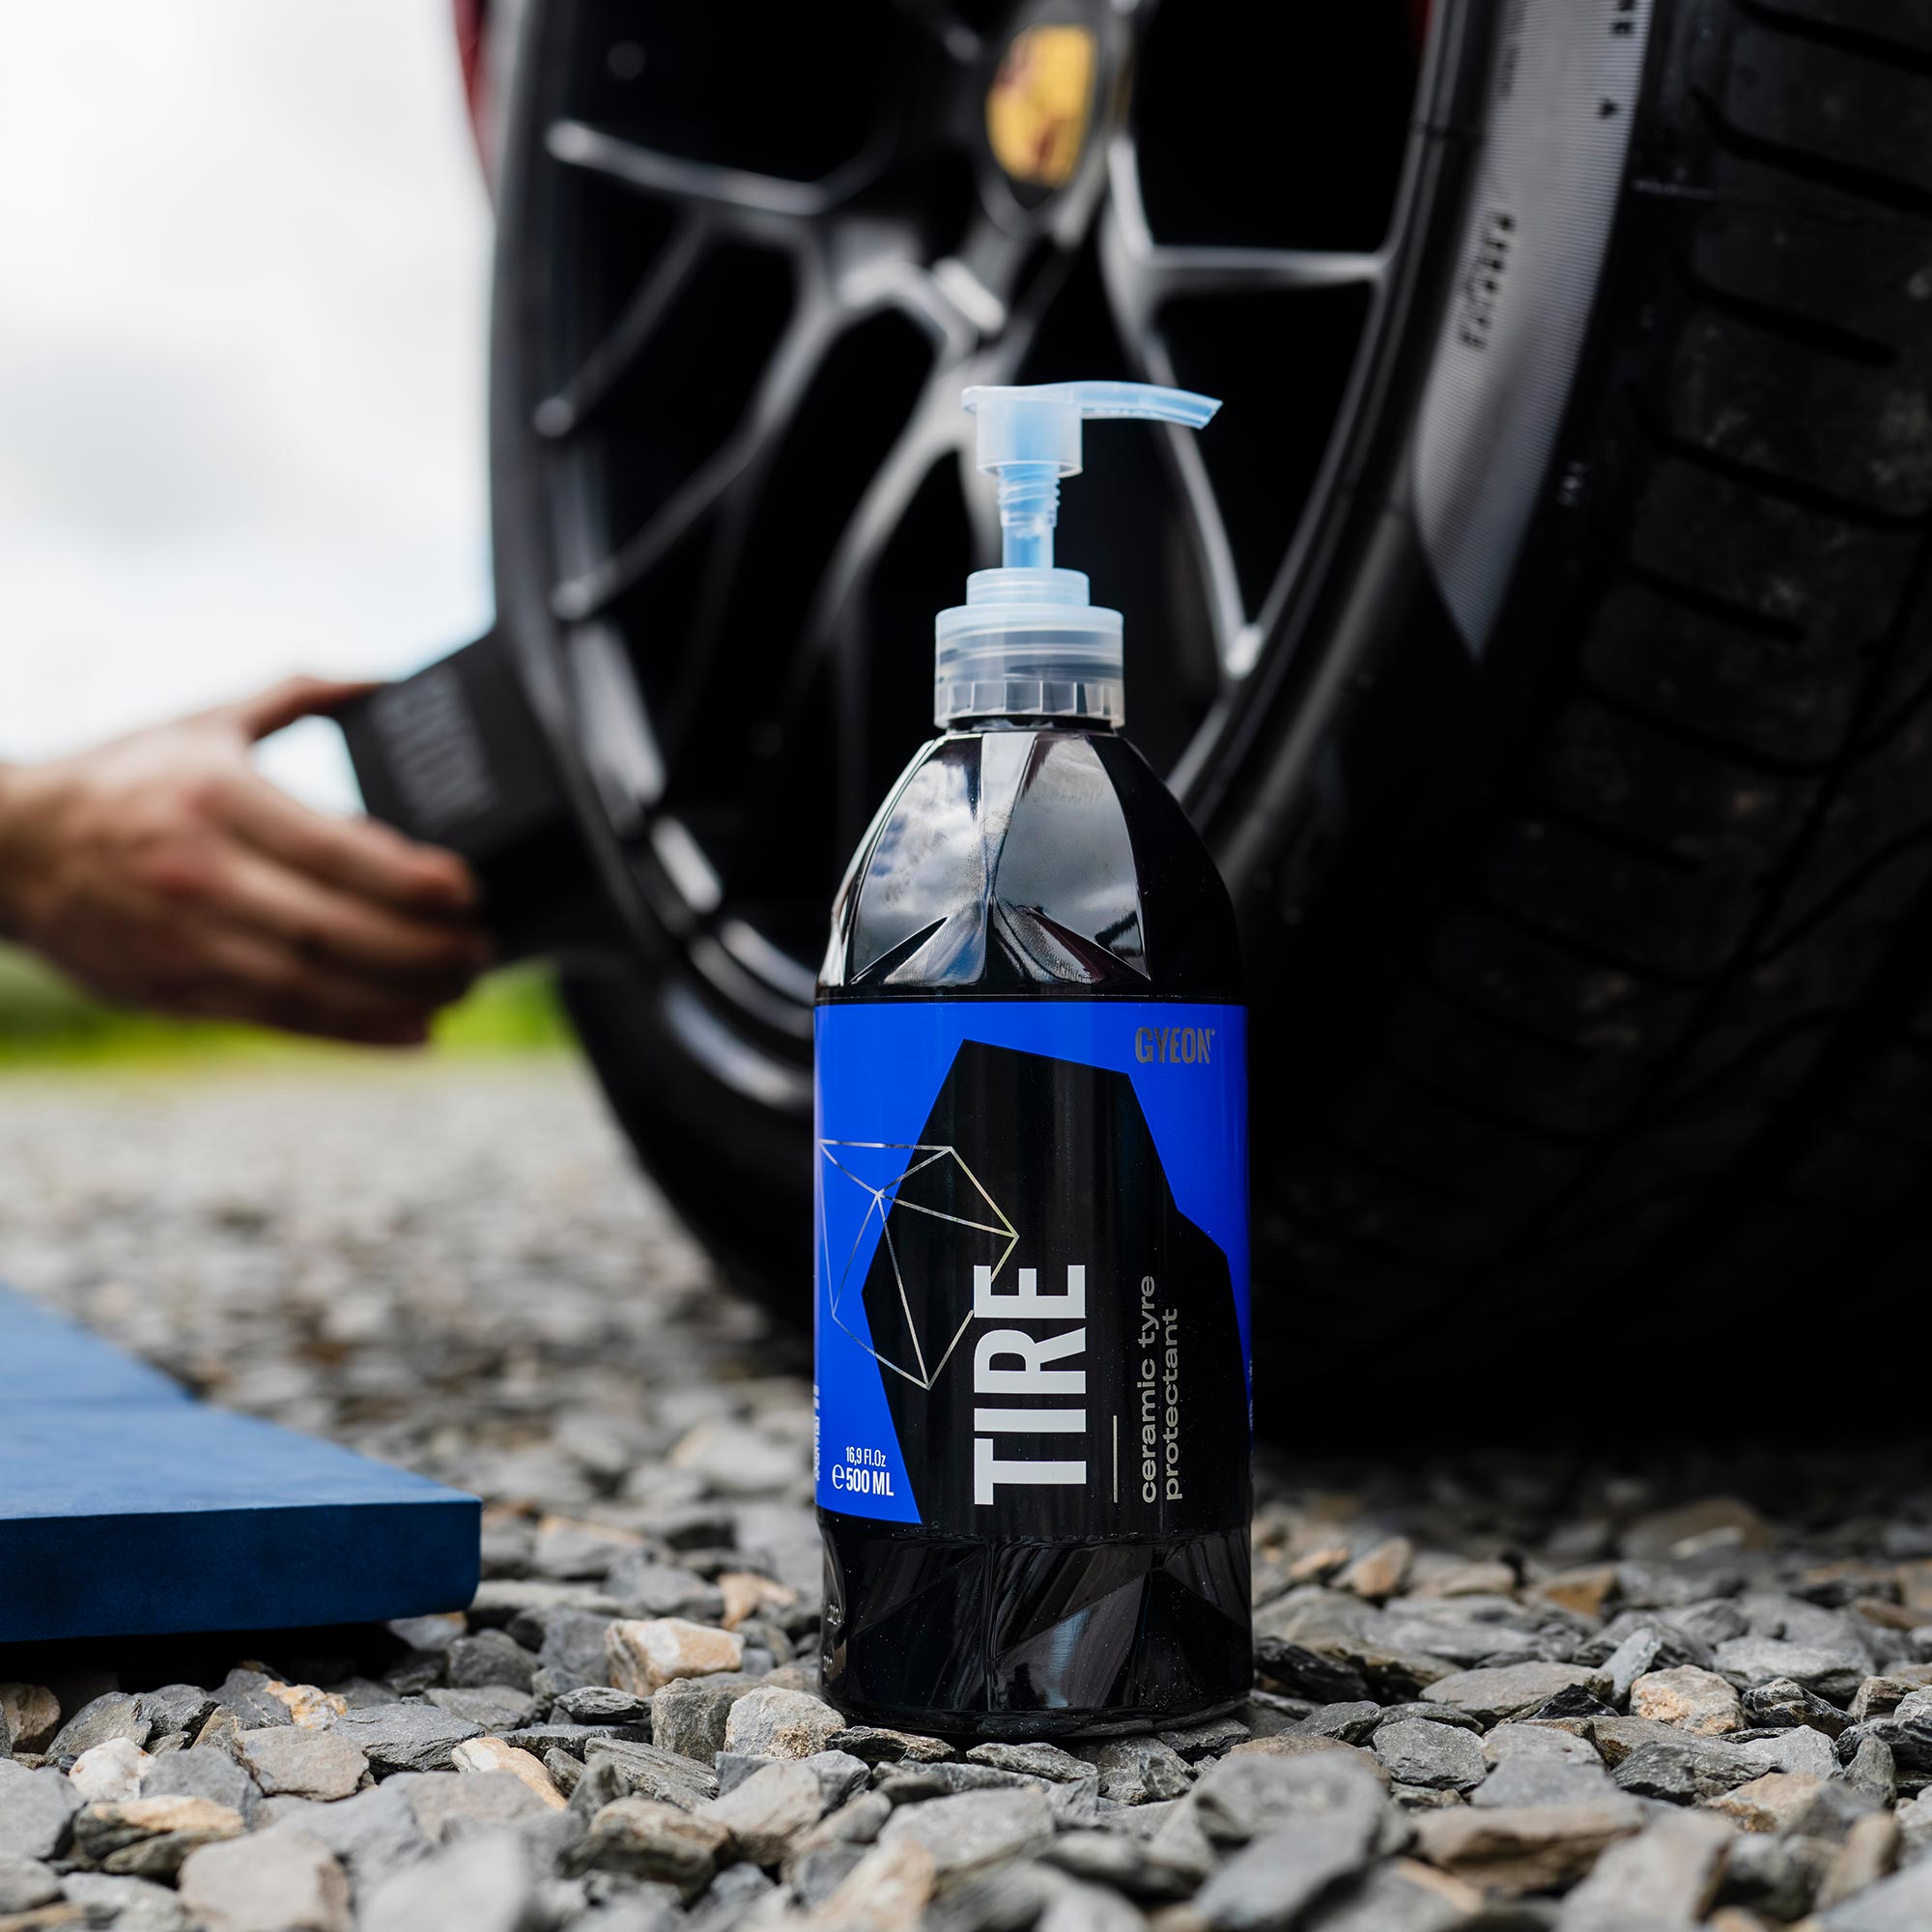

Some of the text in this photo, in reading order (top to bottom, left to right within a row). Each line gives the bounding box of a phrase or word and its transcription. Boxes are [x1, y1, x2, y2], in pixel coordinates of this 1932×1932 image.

[1135, 1027, 1210, 1064] GYEON
[974, 1264, 1086, 1505] TIRE
[1137, 1275, 1159, 1503] ceramic tyre
[1162, 1308, 1182, 1500] protectant
[845, 1446, 862, 1465] 16,9
[872, 1470, 895, 1496] ML
